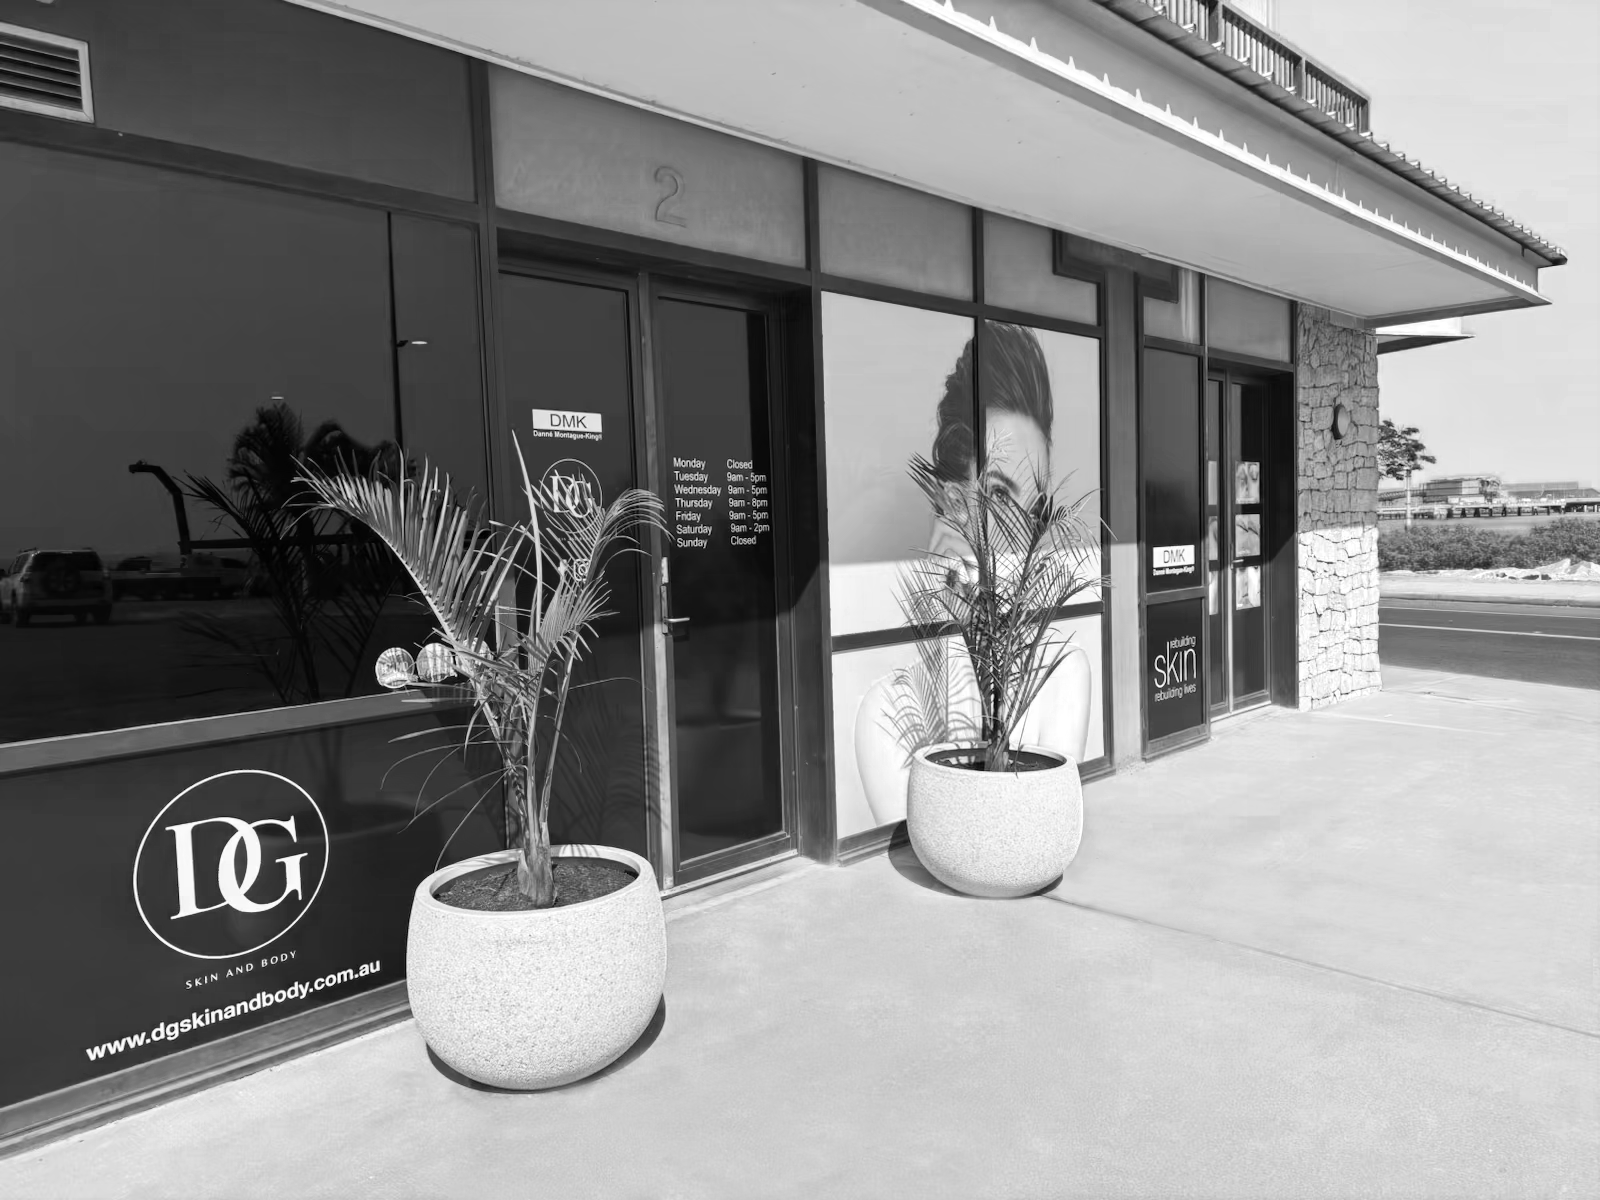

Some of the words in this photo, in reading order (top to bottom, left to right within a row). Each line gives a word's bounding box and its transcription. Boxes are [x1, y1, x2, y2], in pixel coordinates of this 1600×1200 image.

[654, 166, 687, 228] 2
[550, 414, 587, 429] DMK
[673, 457, 706, 470] Monday
[726, 458, 753, 469] Closed
[674, 470, 708, 483] Tuesday
[726, 472, 744, 482] 9am
[750, 472, 767, 484] 5pm
[674, 484, 722, 496] Wednesday
[728, 485, 745, 495] 9am
[751, 485, 768, 496] 5pm
[675, 498, 713, 510] Thursday
[728, 498, 745, 507] 9am
[752, 498, 768, 509] 8pm
[675, 510, 701, 523] Friday
[729, 510, 746, 520] 9am
[752, 510, 769, 521] 5pm
[676, 524, 713, 536] Saturday
[730, 523, 747, 533] 9am
[754, 523, 770, 534] 2pm
[677, 537, 708, 549] Sunday
[730, 535, 757, 546] Closed
[1164, 548, 1185, 563] DMK
[1154, 641, 1196, 688] skin
[165, 815, 308, 920] DG
[185, 972, 218, 989] SKIN
[226, 963, 254, 978] AND
[261, 950, 297, 968] BODY
[85, 960, 381, 1061] www.dgskinandbody.com.au
